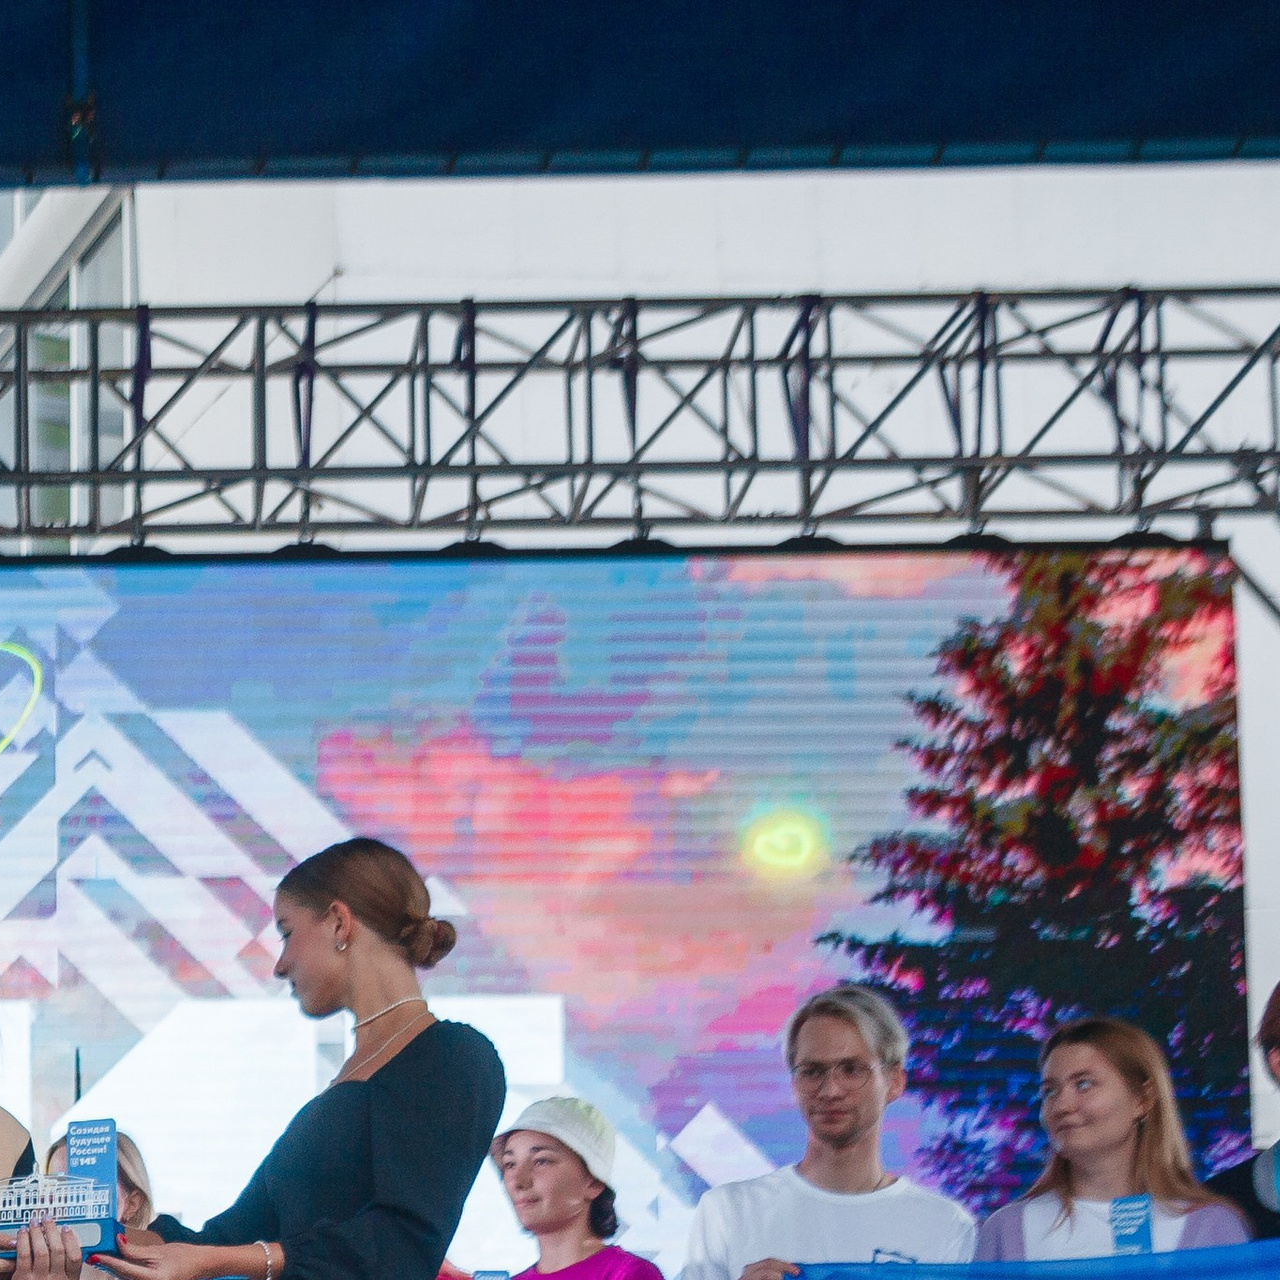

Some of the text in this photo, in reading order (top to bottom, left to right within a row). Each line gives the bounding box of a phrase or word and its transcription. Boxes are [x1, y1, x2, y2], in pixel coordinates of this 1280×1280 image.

[70, 1125, 110, 1136] Созидая
[69, 1136, 111, 1147] будущее
[70, 1145, 107, 1156] России!
